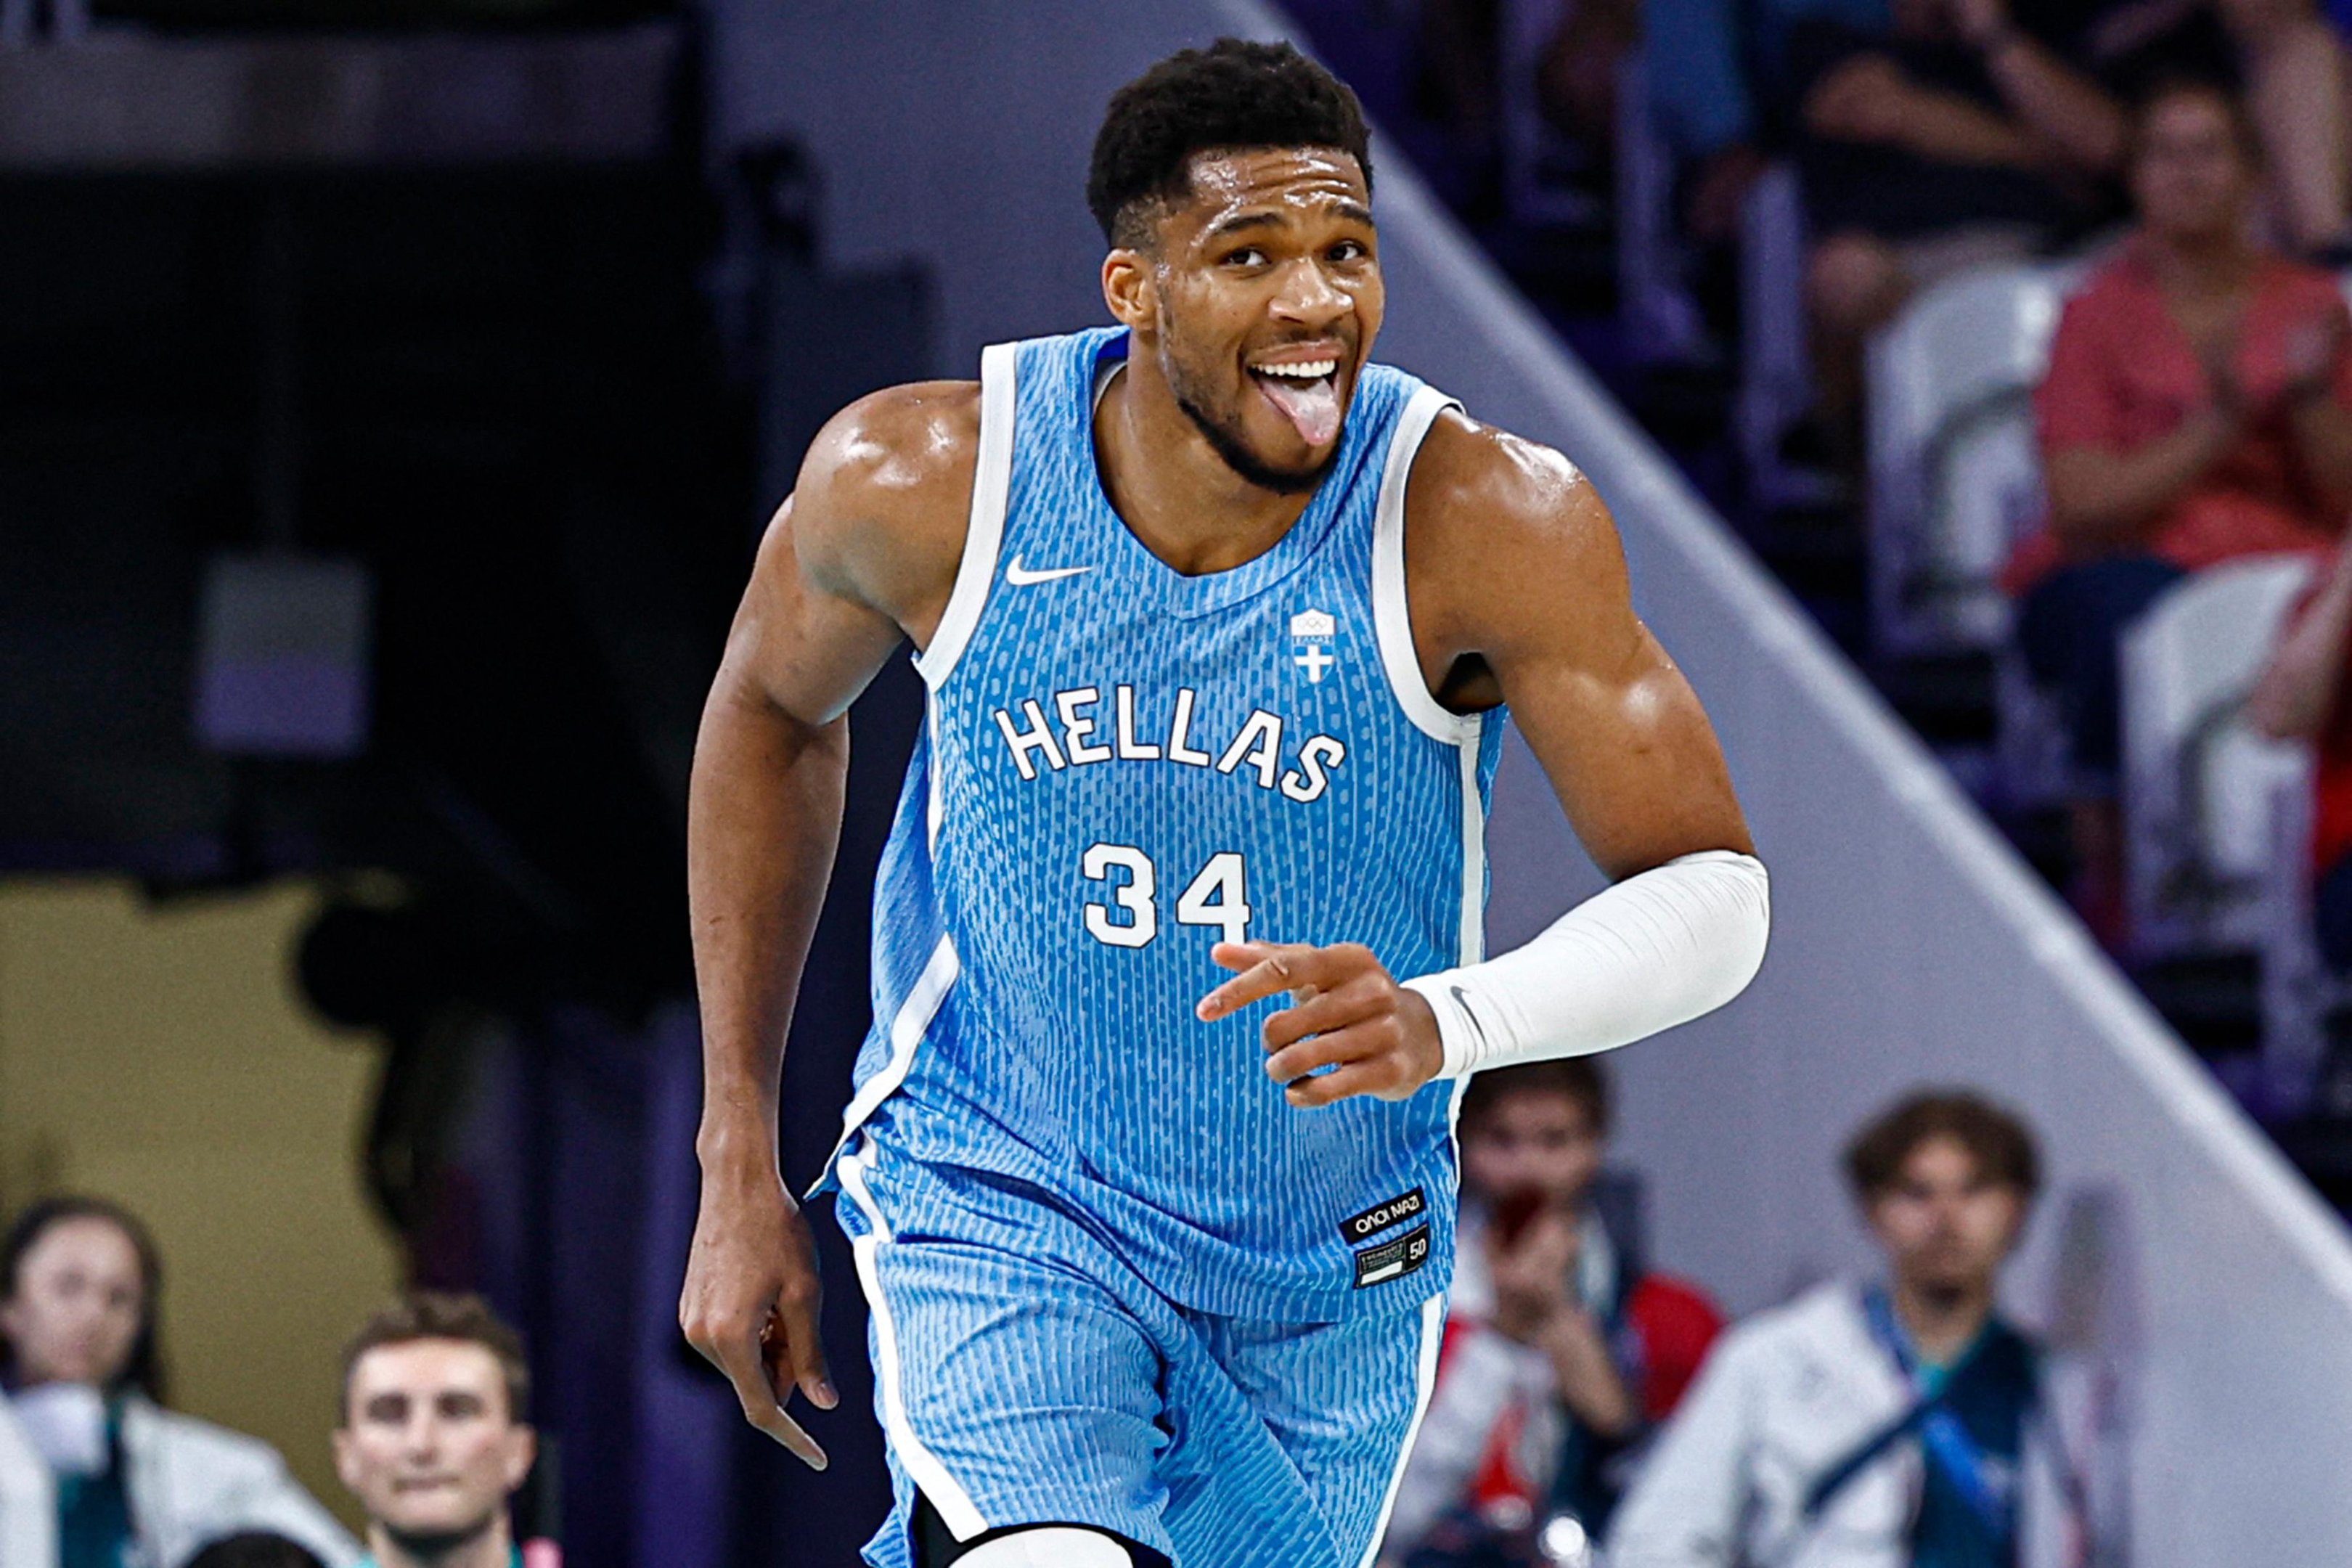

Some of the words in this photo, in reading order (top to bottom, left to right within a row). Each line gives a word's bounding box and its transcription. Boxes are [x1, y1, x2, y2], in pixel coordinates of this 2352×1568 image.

[995, 685, 1347, 803] HELLAS
[1082, 842, 1251, 949] 34
[1410, 1238, 1426, 1259] 50
